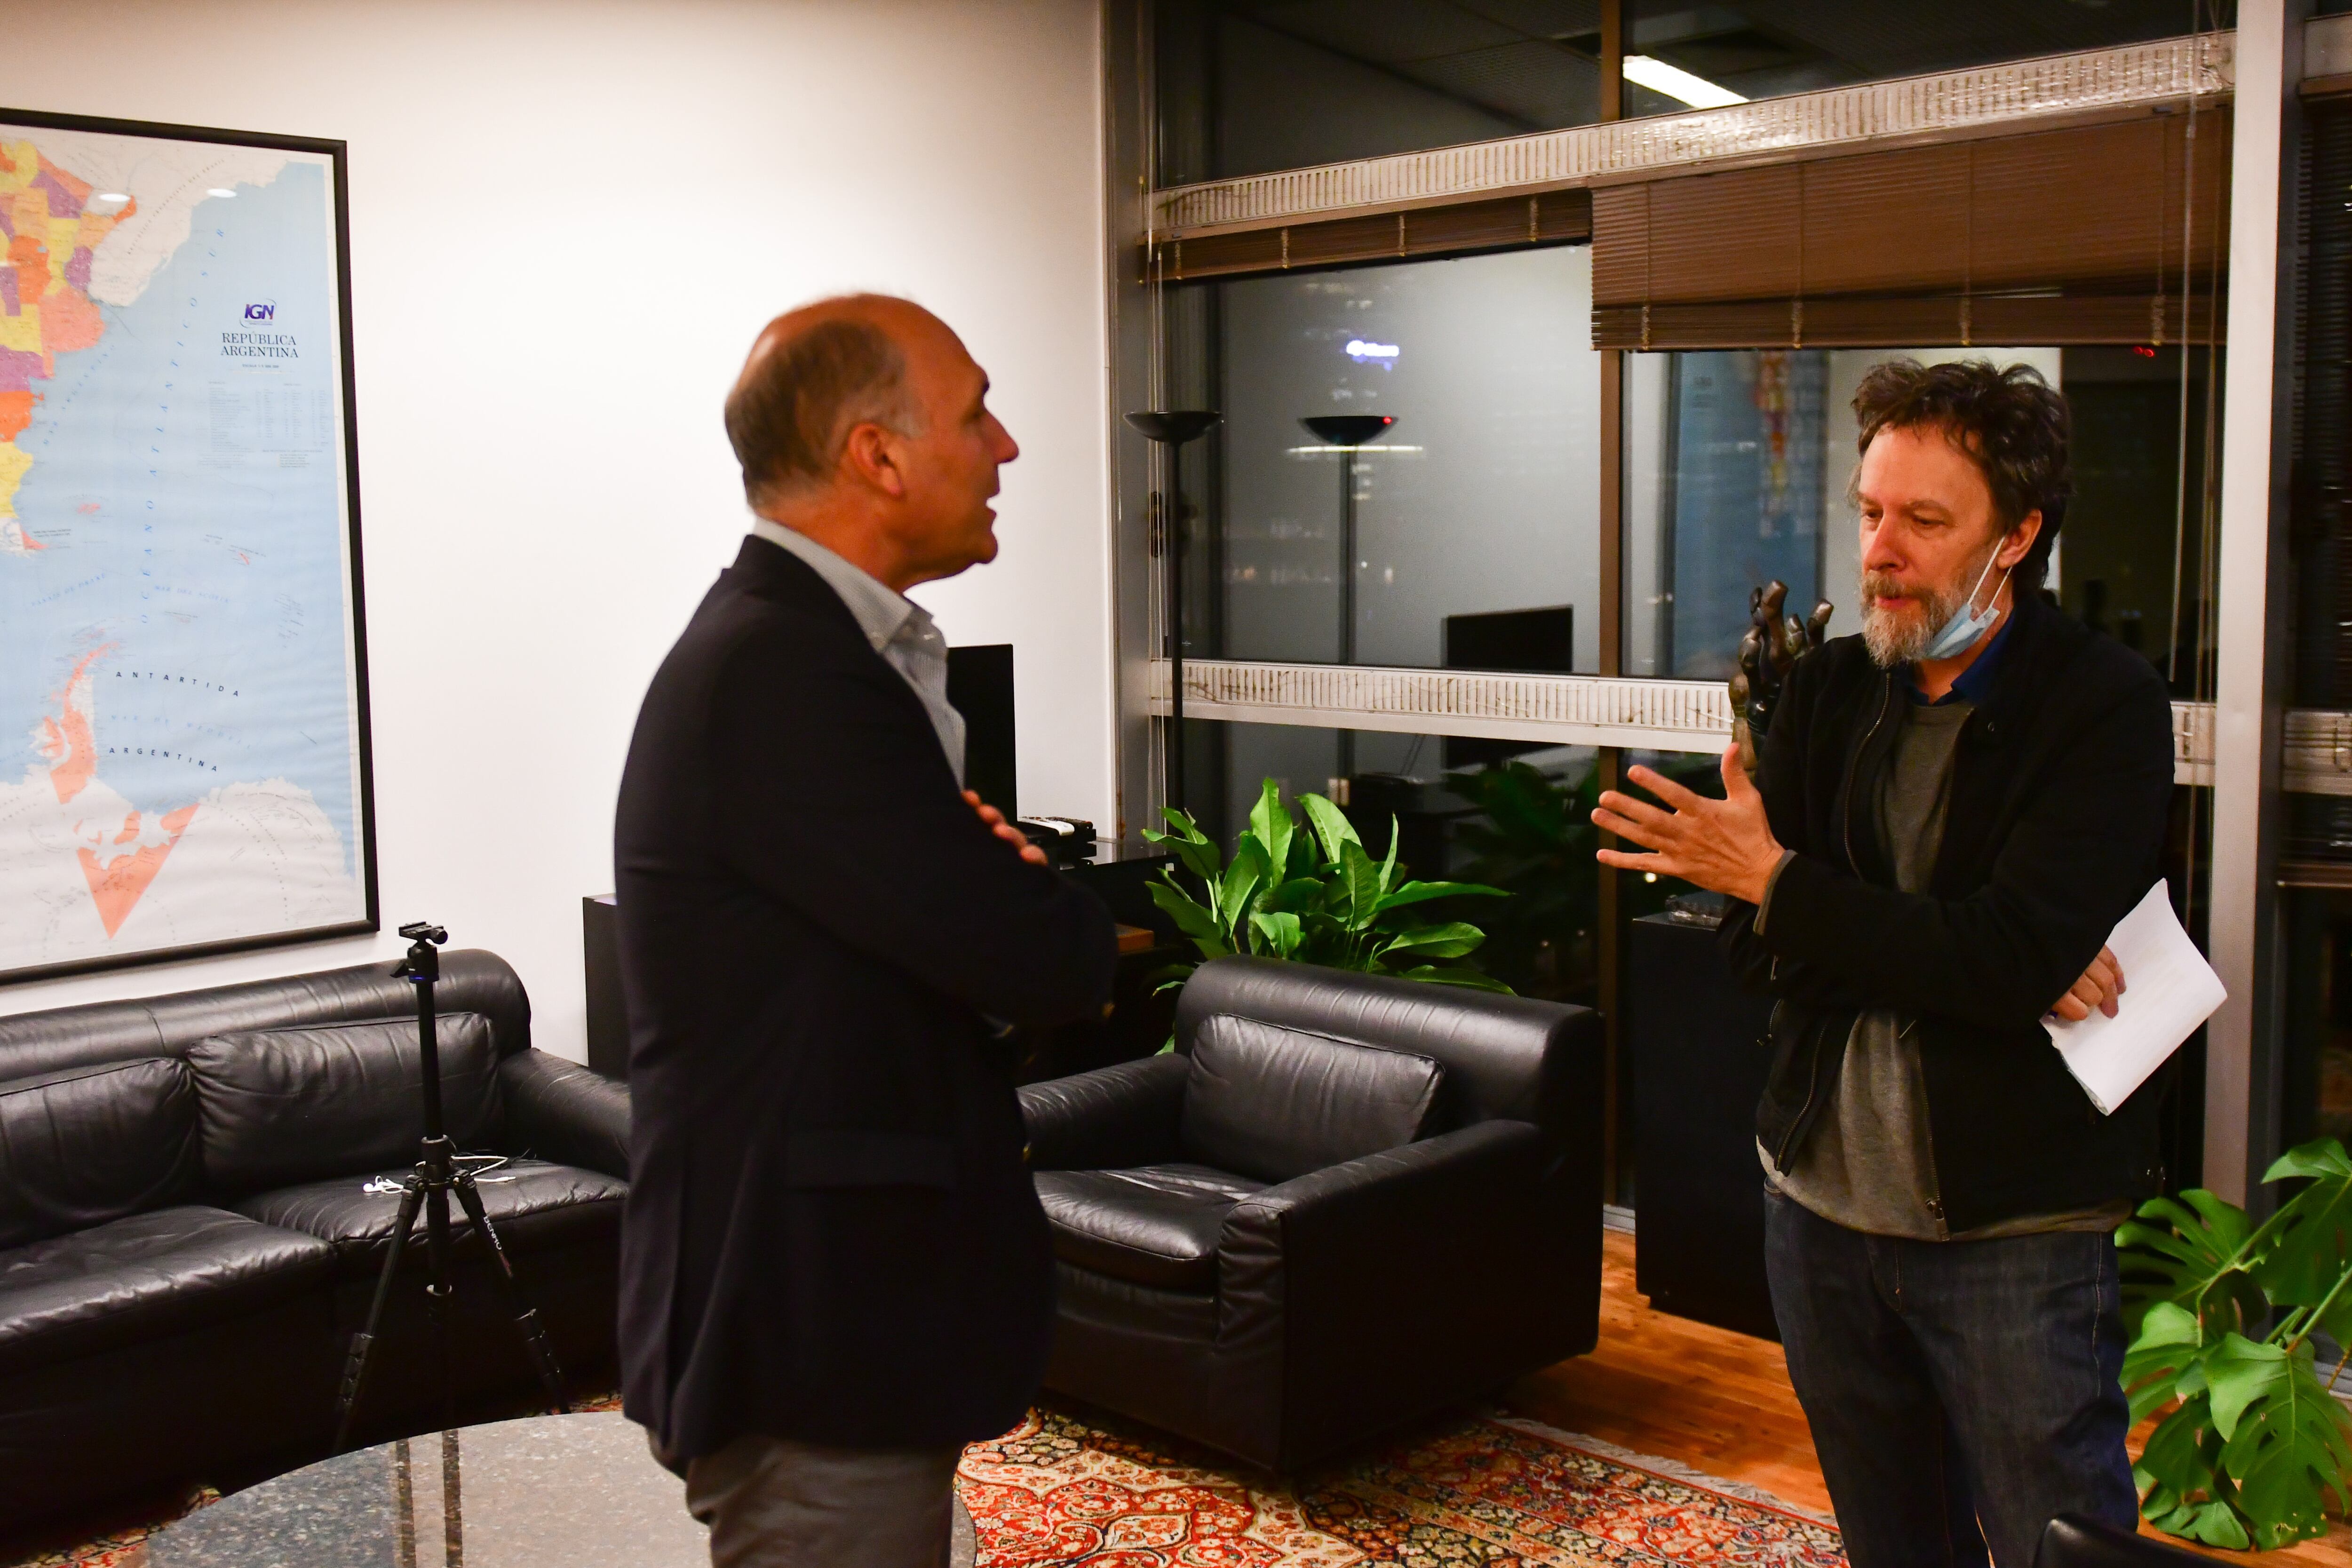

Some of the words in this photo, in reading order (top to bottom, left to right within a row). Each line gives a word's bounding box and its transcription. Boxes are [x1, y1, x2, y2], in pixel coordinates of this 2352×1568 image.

[244, 303, 274, 320] IGN
[222, 331, 297, 346] REPÚBLICA
[220, 345, 299, 358] ARGENTINA
[109, 747, 218, 772] ARGENTINA
